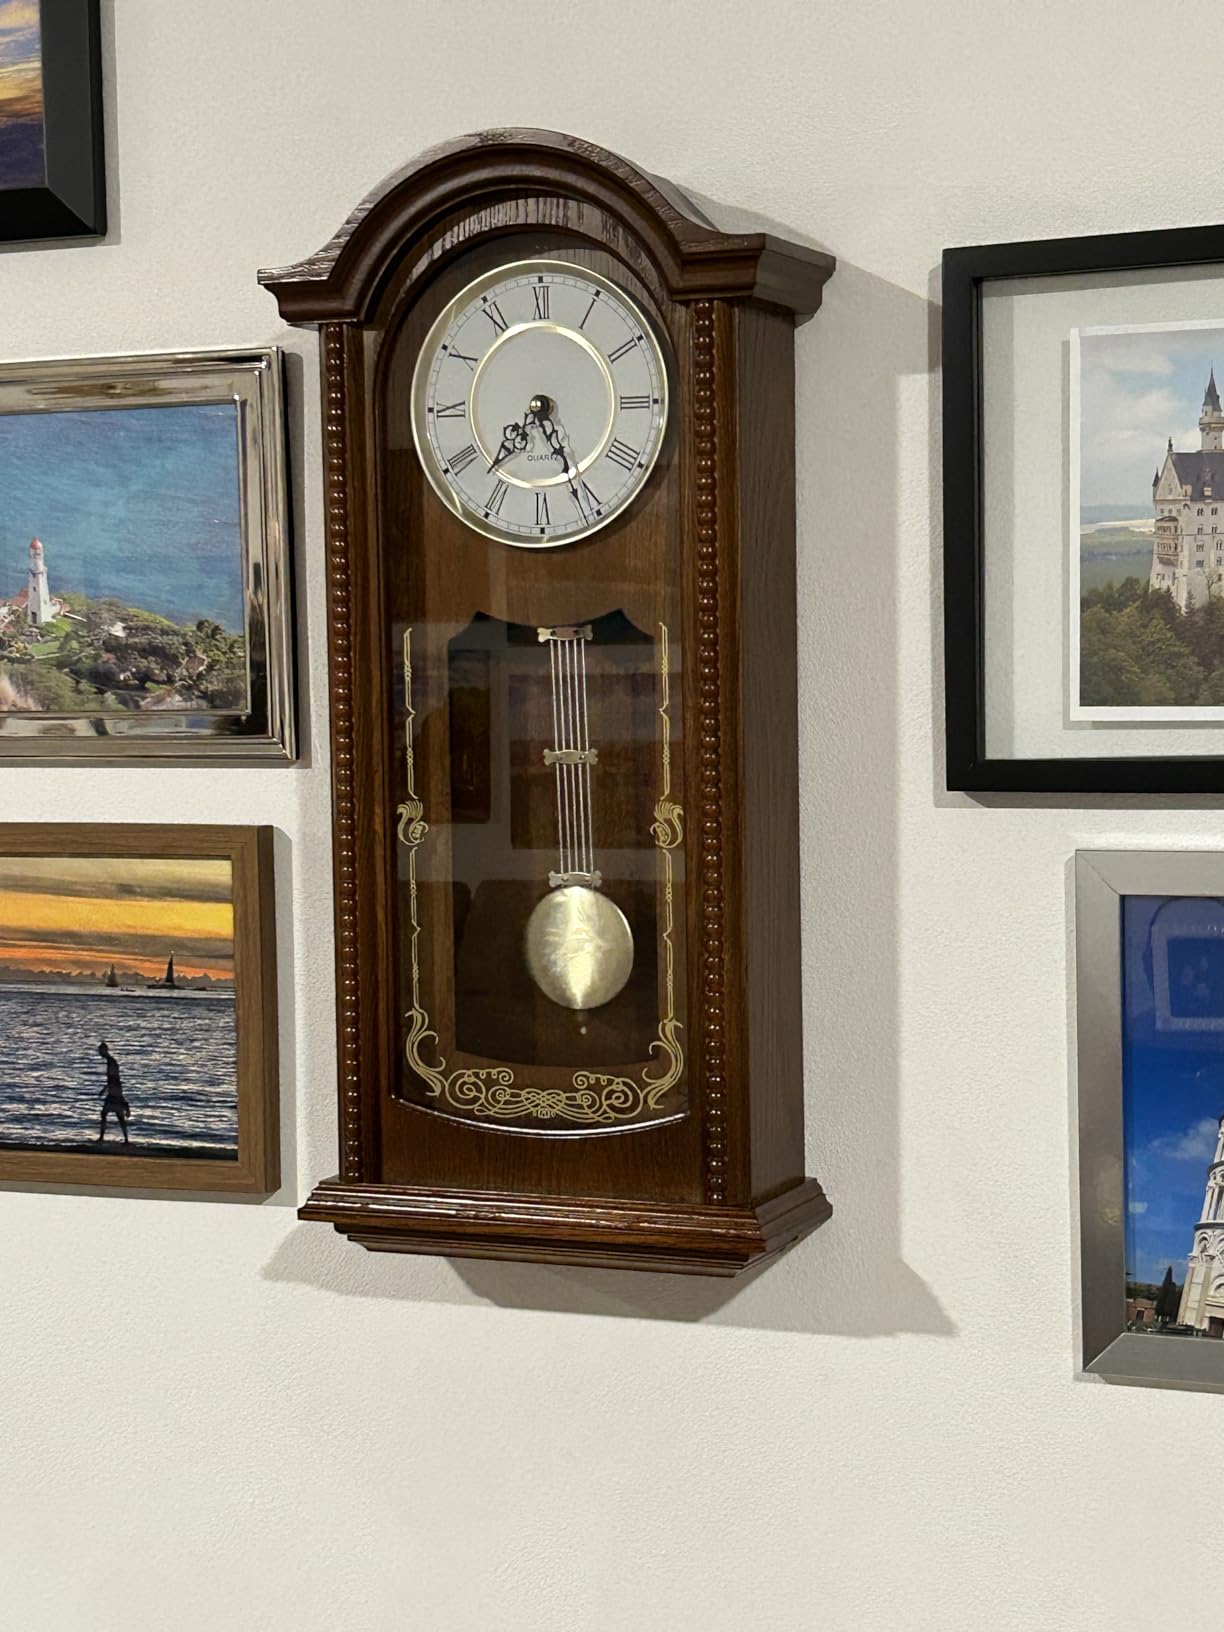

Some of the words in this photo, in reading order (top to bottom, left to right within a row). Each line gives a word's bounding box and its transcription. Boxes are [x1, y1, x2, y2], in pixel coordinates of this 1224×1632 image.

[481, 300, 510, 338] XI
[531, 285, 550, 321] XII
[578, 298, 598, 330] I
[447, 345, 479, 372] X
[607, 337, 638, 365] II
[436, 399, 466, 419] IX
[619, 394, 651, 411] III
[446, 443, 480, 477] VIII
[605, 437, 641, 473] IIII
[484, 479, 510, 516] VII
[534, 492, 552, 526] VI
[580, 478, 603, 509] V
